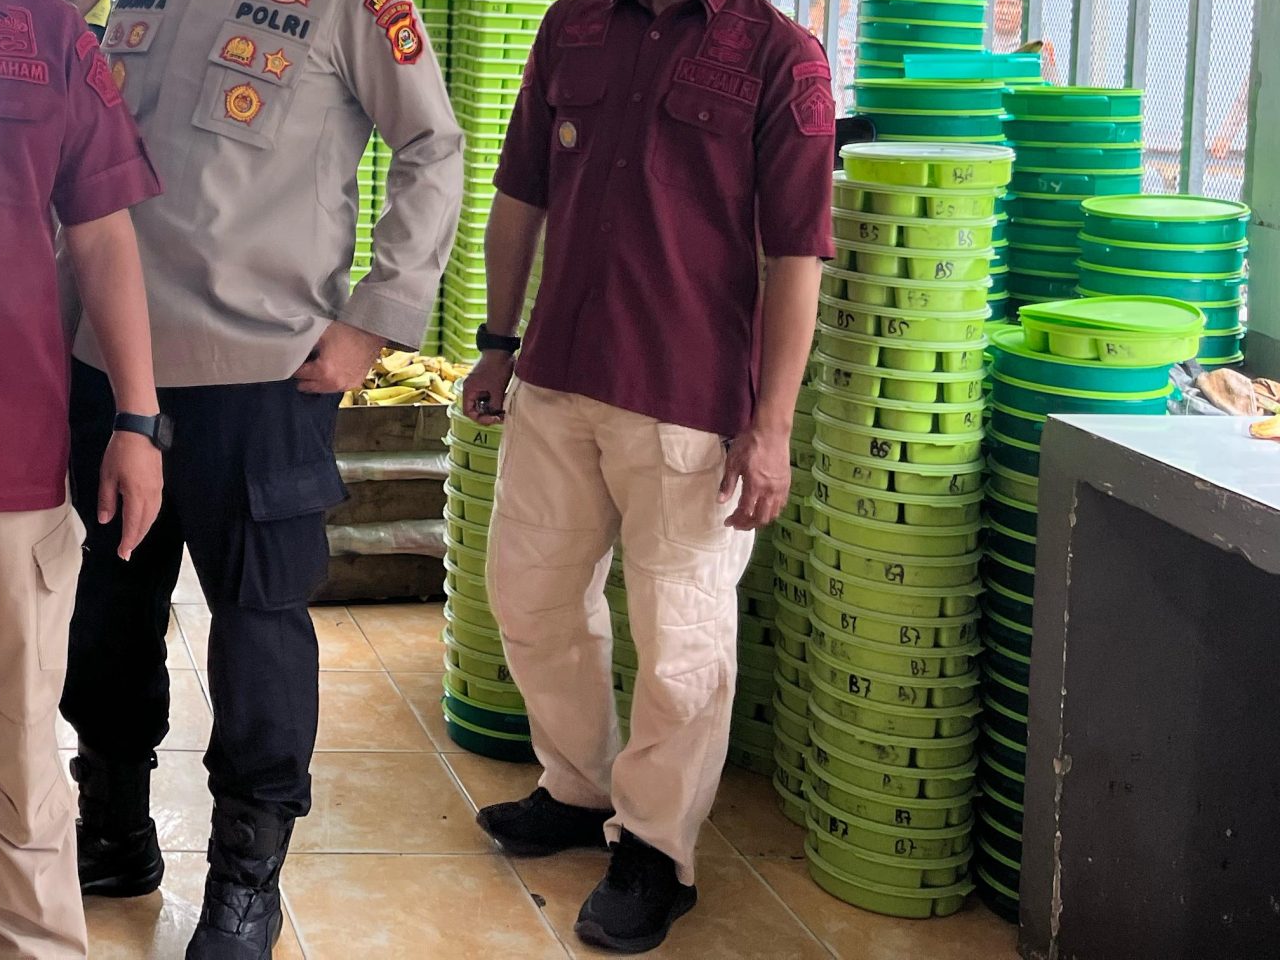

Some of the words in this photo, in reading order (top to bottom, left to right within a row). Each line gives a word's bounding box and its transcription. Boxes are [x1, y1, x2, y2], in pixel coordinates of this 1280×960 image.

[235, 1, 311, 39] POLRI
[841, 612, 857, 635] B7
[900, 626, 922, 646] B7
[848, 674, 871, 699] B7
